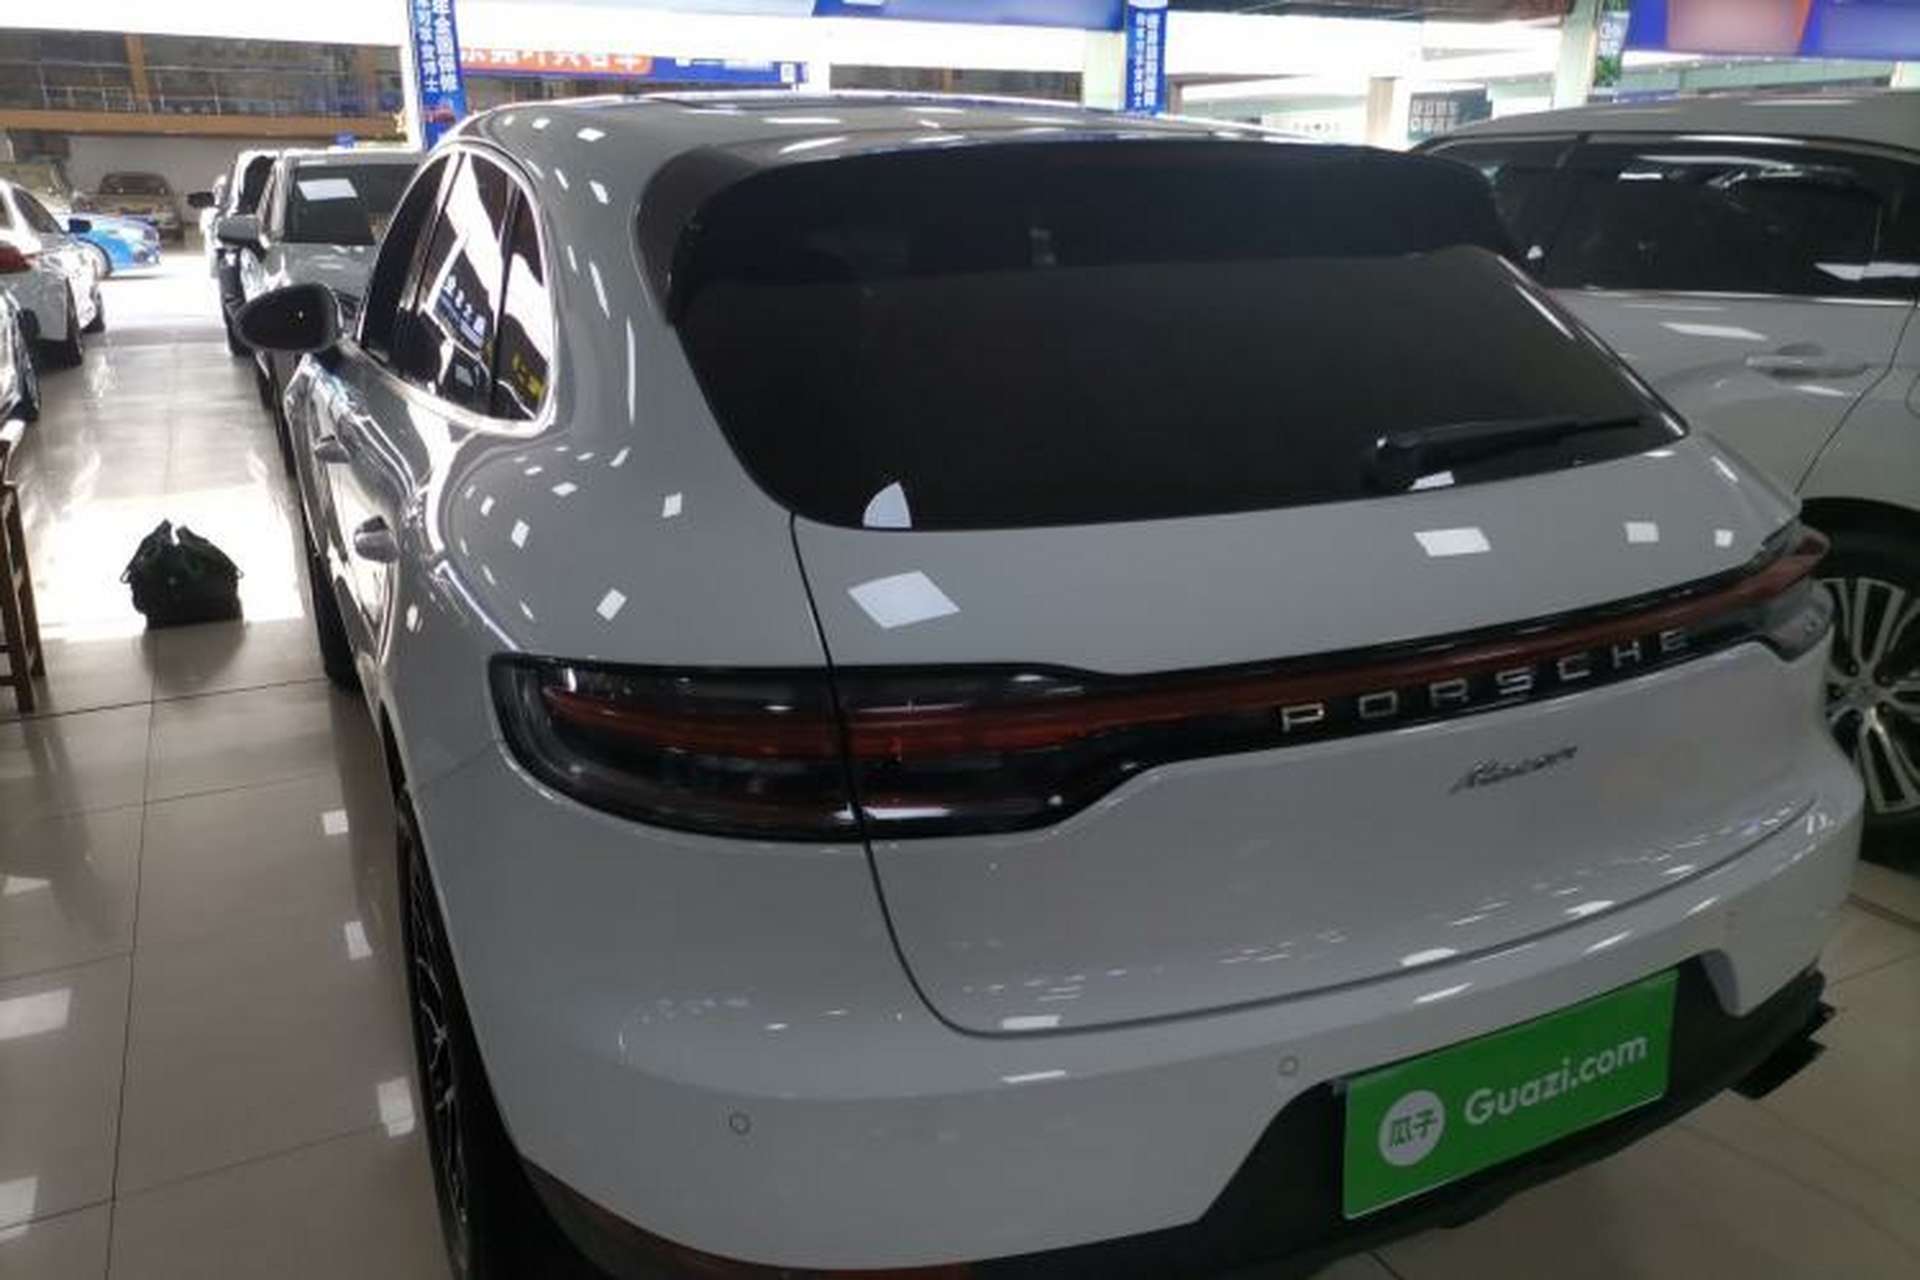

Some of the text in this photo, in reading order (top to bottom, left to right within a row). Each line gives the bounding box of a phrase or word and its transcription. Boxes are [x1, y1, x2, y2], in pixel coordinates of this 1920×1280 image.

[1281, 628, 1689, 734] PORSCHE
[1464, 1036, 1648, 1125] Guazi.com
[1388, 1108, 1439, 1148] 瓜子
